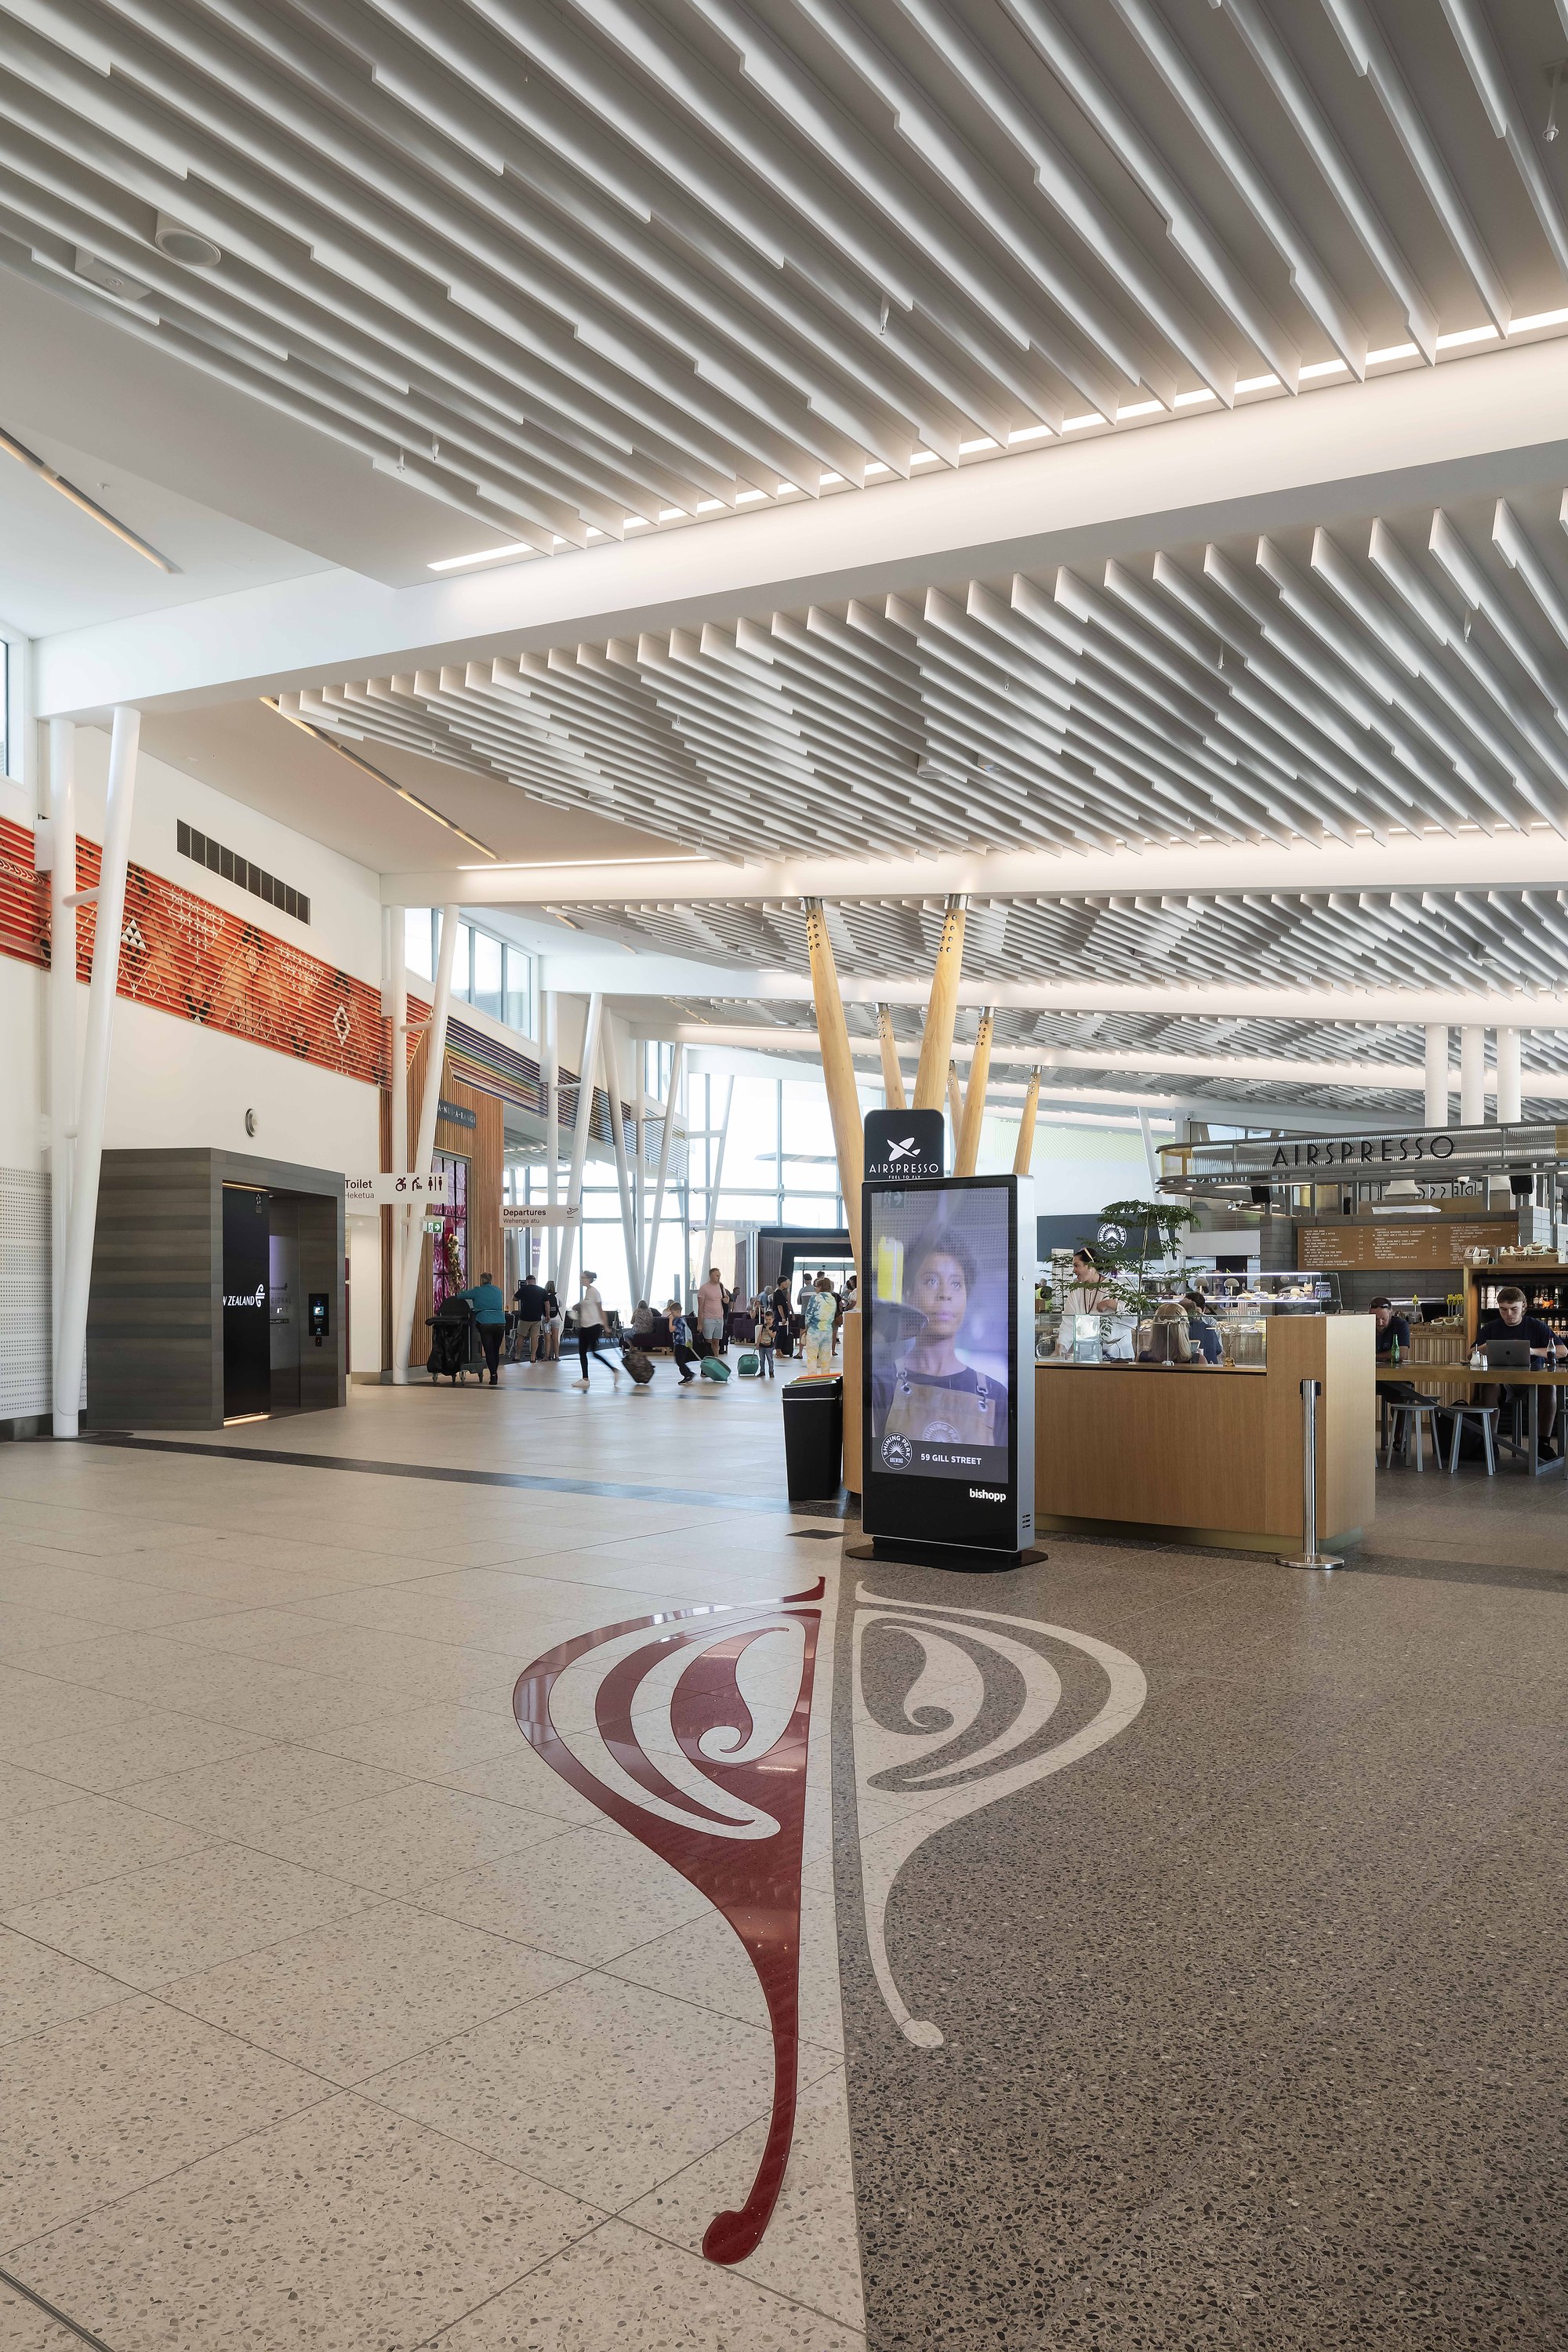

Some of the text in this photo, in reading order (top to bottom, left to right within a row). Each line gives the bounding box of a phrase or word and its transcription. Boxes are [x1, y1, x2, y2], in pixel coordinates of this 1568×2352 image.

[1272, 1135, 1455, 1167] AIRSPRESSO
[869, 1163, 939, 1174] AIRSPRESSO
[345, 1178, 372, 1189] Toilet
[503, 1208, 546, 1218] Departures
[1098, 1223, 1116, 1242] SHINING
[227, 1295, 255, 1306] ZEALAND
[883, 1436, 911, 1457] SHINING PEAK
[931, 1454, 949, 1463] GILL
[951, 1456, 982, 1465] STREET
[969, 1488, 1007, 1502] bishopp
